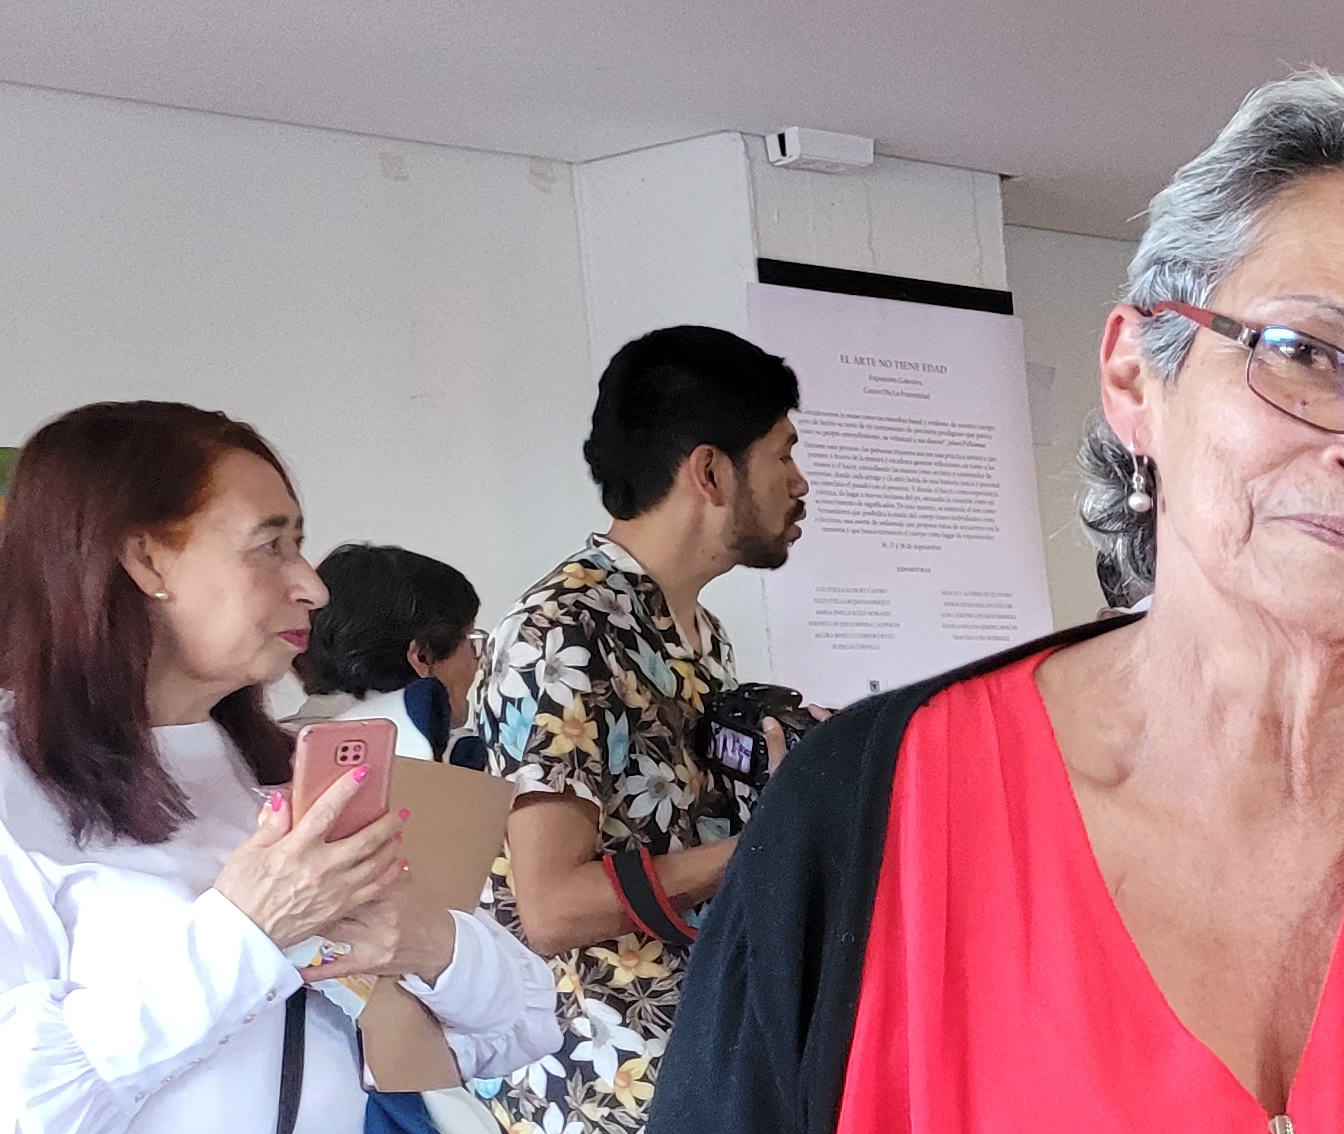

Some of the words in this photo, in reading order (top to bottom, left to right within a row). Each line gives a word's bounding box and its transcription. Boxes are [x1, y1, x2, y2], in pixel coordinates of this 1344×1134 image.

[840, 354, 849, 364] EL
[854, 356, 876, 367] ARTE
[879, 358, 892, 368] NO
[894, 360, 919, 371] TIENE
[922, 363, 947, 374] EDAD
